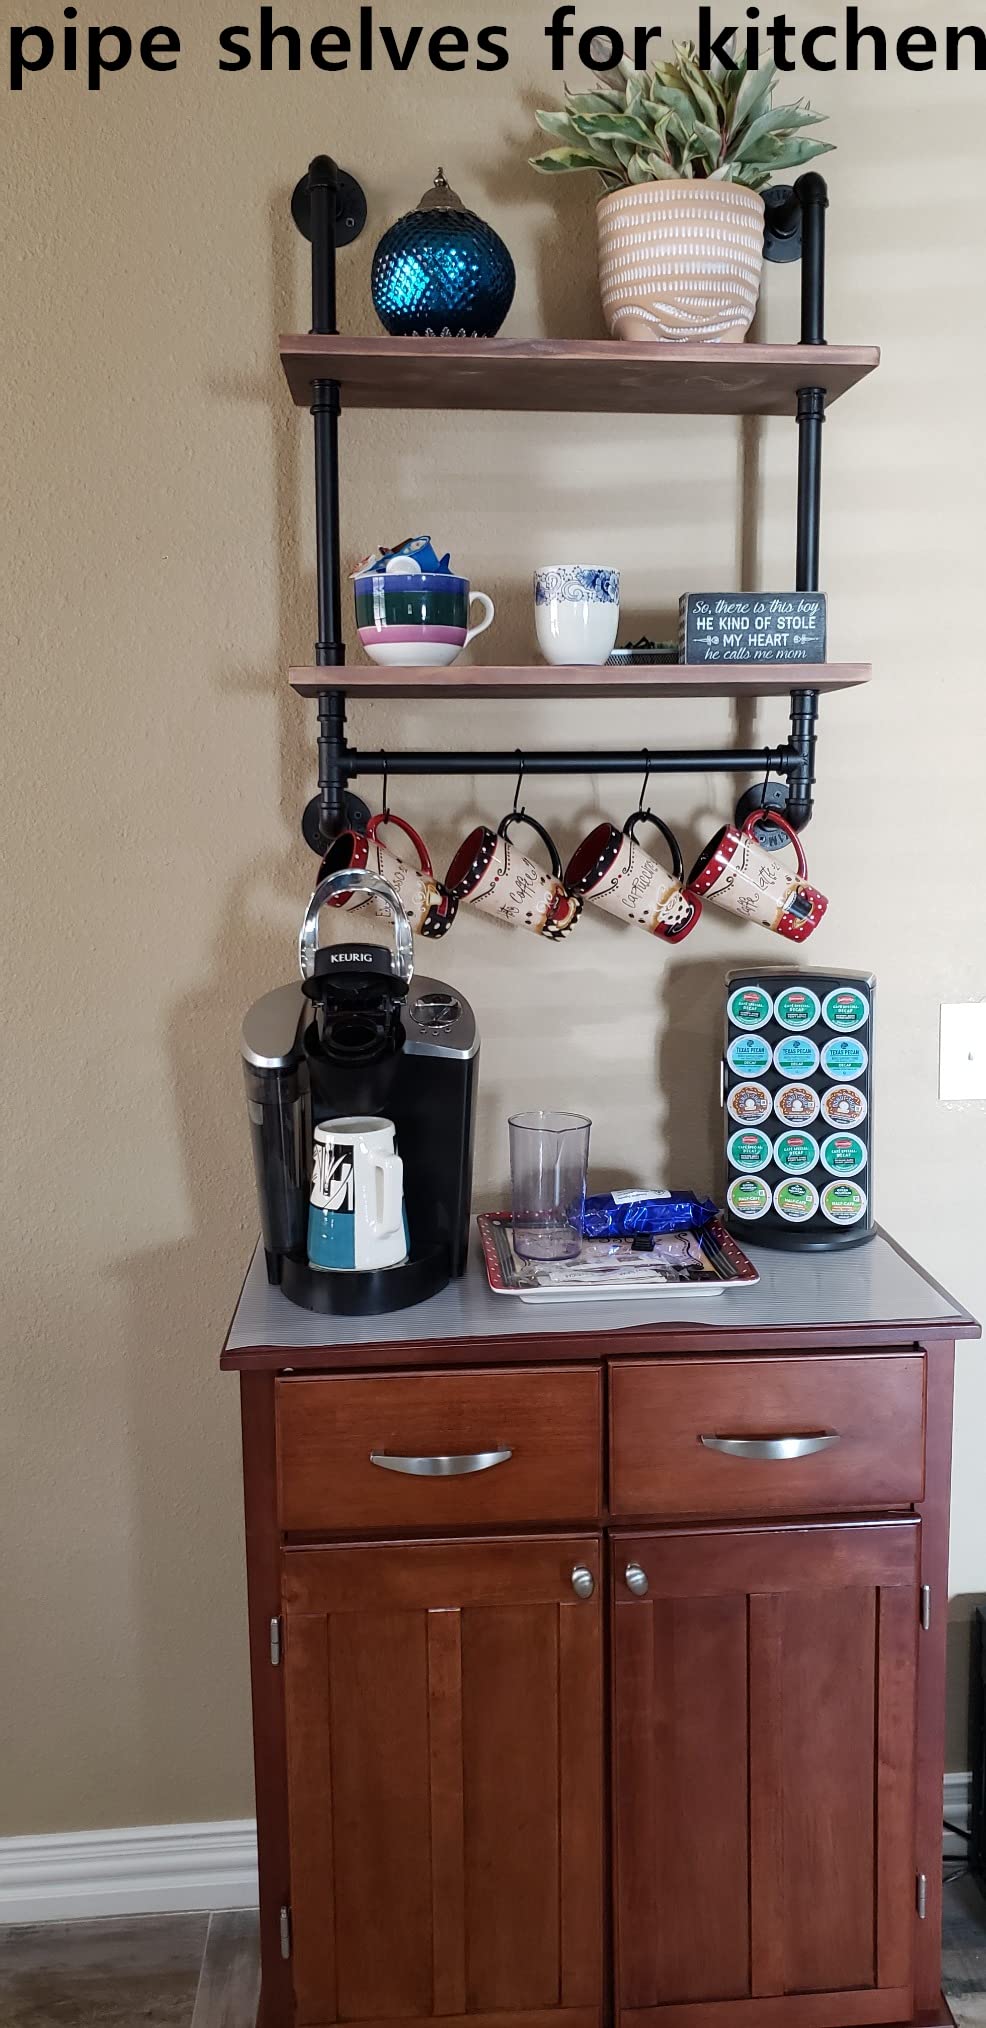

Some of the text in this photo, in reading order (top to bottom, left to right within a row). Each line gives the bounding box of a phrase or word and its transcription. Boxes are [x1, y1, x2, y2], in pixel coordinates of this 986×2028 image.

[693, 599, 820, 617] So, there is this boy
[696, 616, 816, 630] HE KIND OF STOLE
[723, 633, 790, 647] MY HEART
[704, 647, 808, 660] he calls me mom
[330, 953, 373, 964] KEURIG
